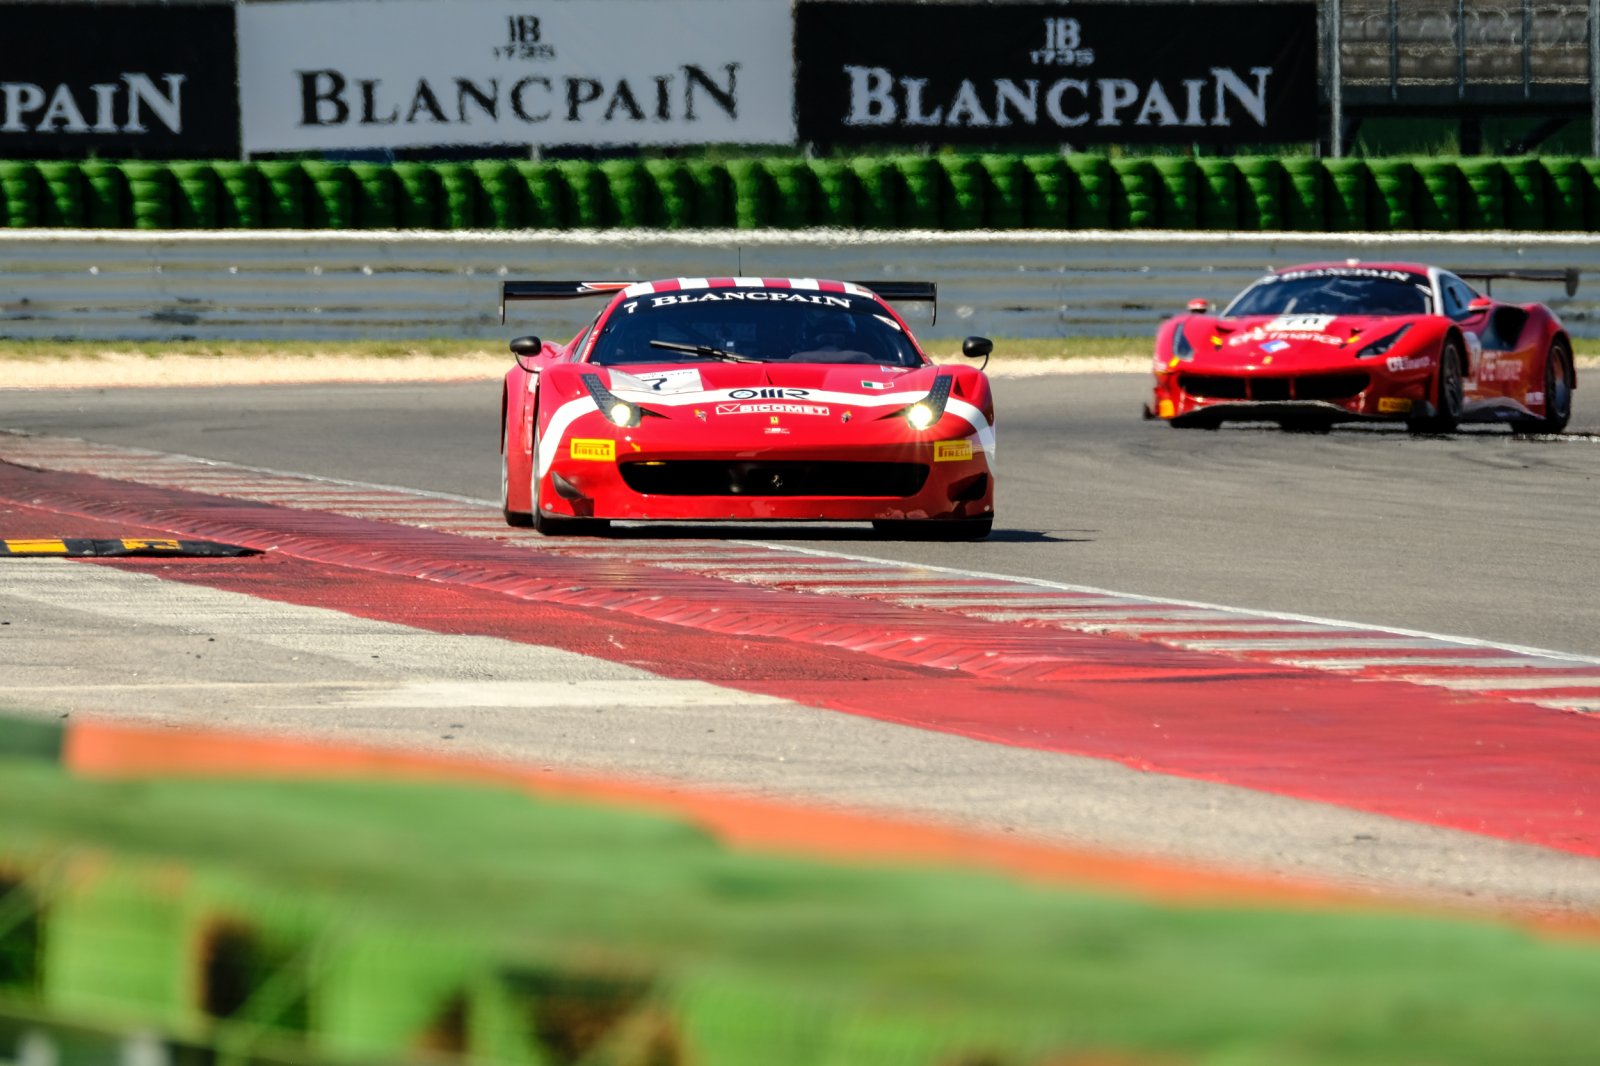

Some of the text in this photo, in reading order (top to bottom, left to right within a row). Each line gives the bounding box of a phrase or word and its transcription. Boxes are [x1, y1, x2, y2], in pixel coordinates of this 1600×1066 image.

[295, 62, 742, 127] BLANCPAIN
[842, 64, 1272, 128] BLANCPAIN
[624, 292, 852, 314] 7 BLANCPAIN
[641, 377, 668, 391] 7
[740, 403, 828, 416] SICOMET
[574, 442, 610, 456] PIRELLI
